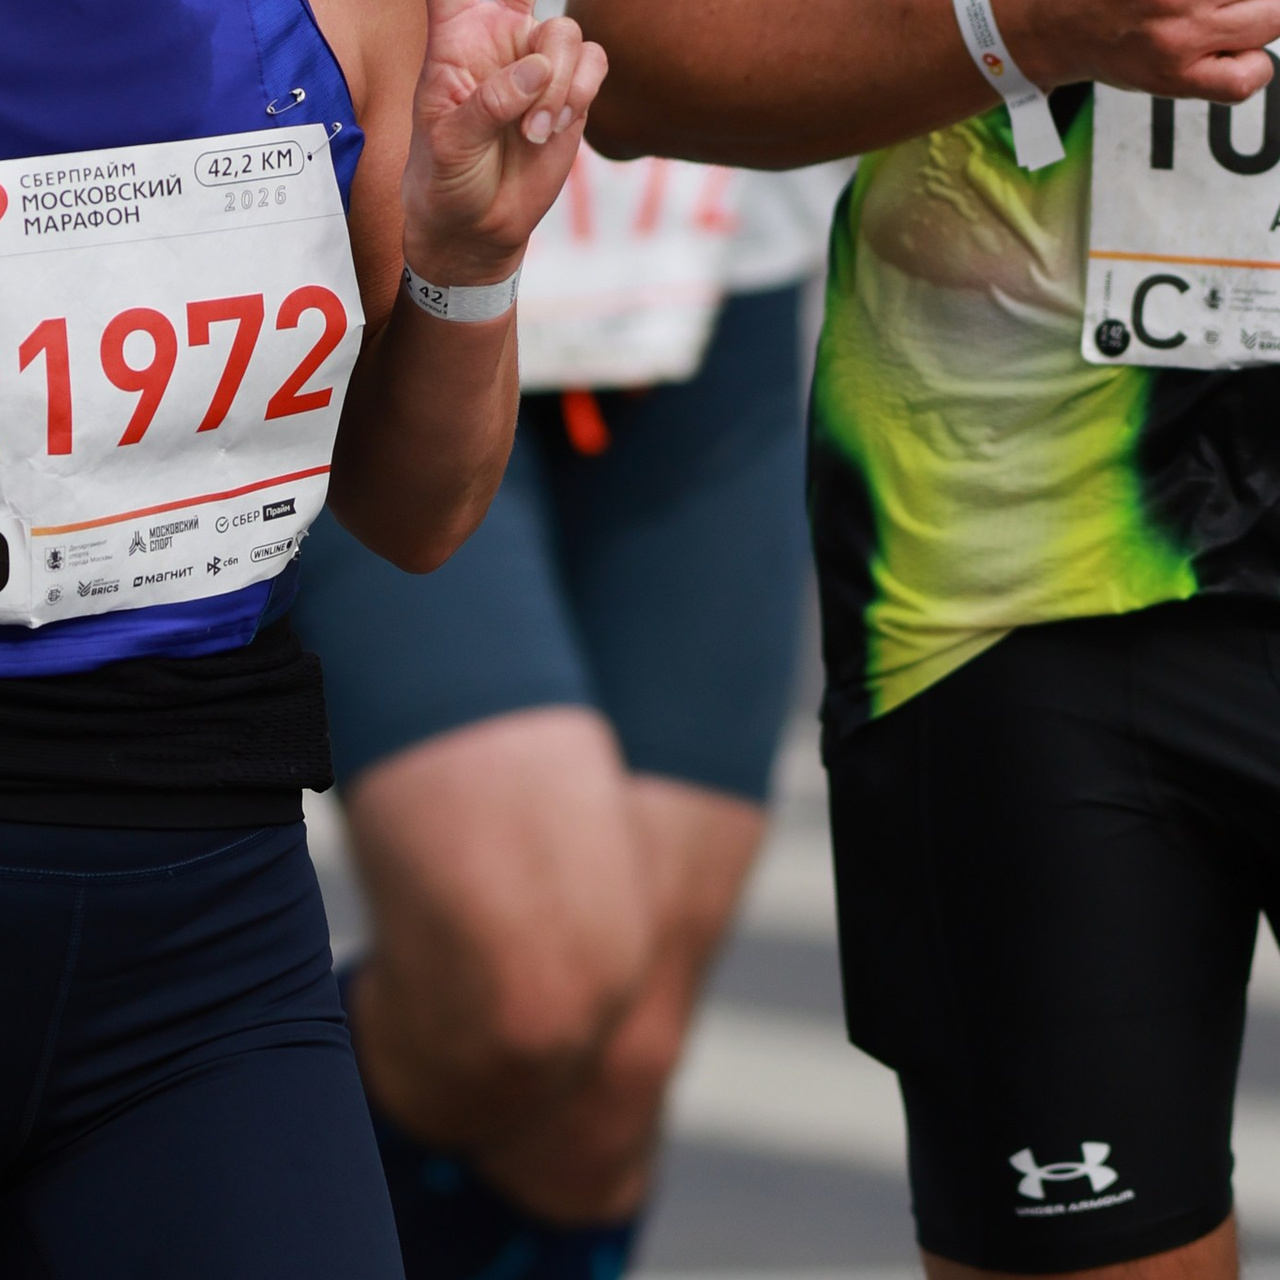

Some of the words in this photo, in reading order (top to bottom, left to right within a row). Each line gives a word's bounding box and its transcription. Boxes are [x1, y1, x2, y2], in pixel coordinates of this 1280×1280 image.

[20, 161, 136, 189] СБЕРПРАЙМ
[208, 154, 252, 178] 42,2
[262, 148, 292, 171] КМ
[22, 173, 183, 213] МОСКОВСКИЙ
[224, 185, 287, 212] 2026
[24, 205, 140, 236] МАРАФОН
[1132, 274, 1190, 350] C
[149, 515, 199, 539] МОСКОВСКИЙ
[232, 510, 260, 527] СБЕР
[265, 504, 291, 517] Прайм
[149, 536, 173, 552] СПОРТ
[253, 543, 286, 559] WINLINE
[91, 584, 119, 596] BRICS
